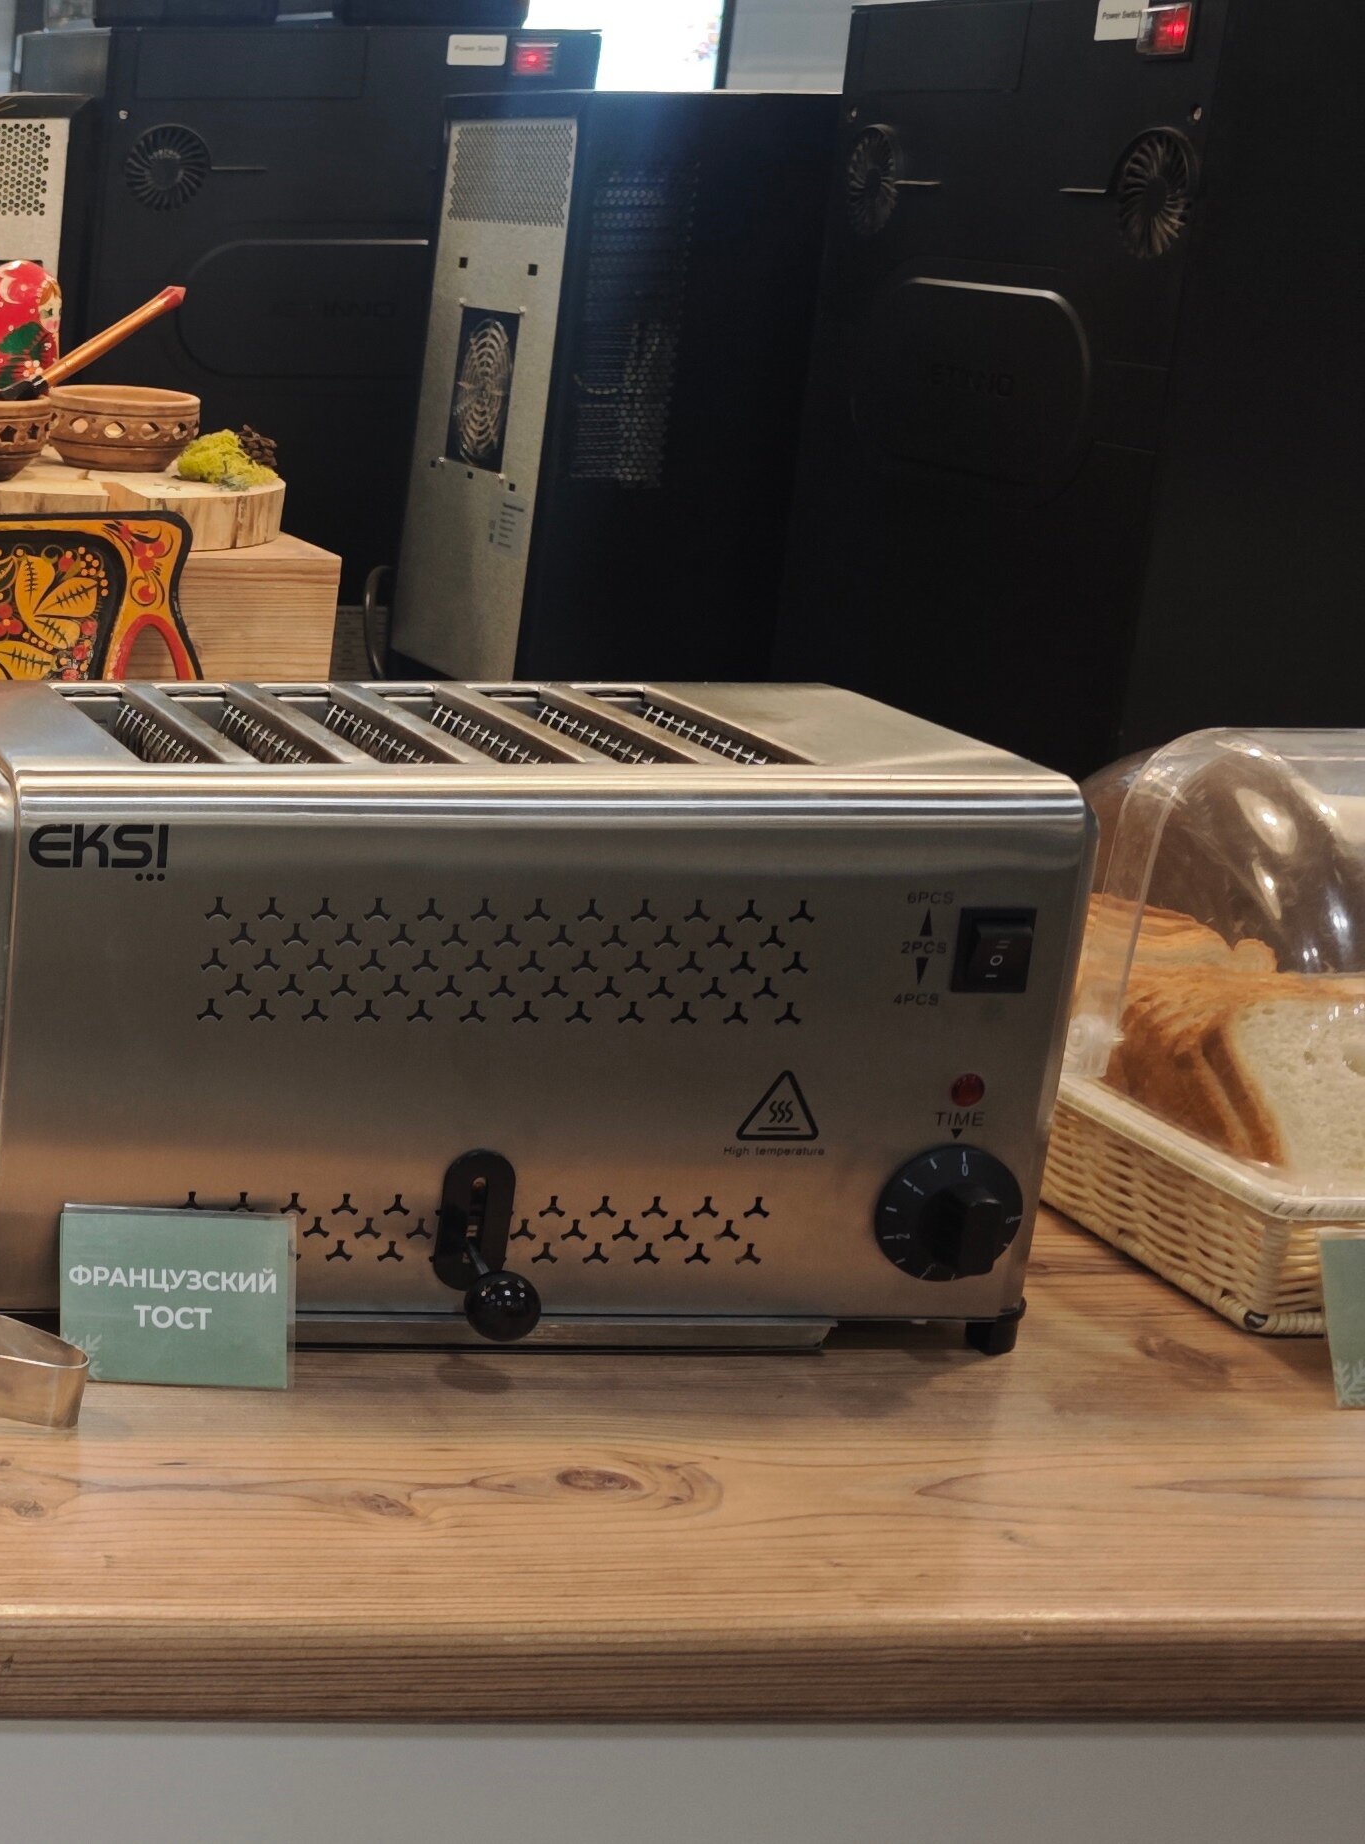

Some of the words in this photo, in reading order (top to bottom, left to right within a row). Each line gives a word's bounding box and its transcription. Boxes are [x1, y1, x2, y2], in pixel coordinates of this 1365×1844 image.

[28, 823, 169, 869] EKSI
[906, 891, 954, 905] 6PCS
[900, 941, 947, 955] 2PCS
[892, 993, 939, 1006] 4PCS
[934, 1111, 985, 1127] TIME
[723, 1146, 749, 1158] High
[755, 1146, 825, 1158] temperature
[68, 1264, 278, 1294] ФРАНЦУЗСКИЙ
[133, 1304, 213, 1331] ТОСТ
